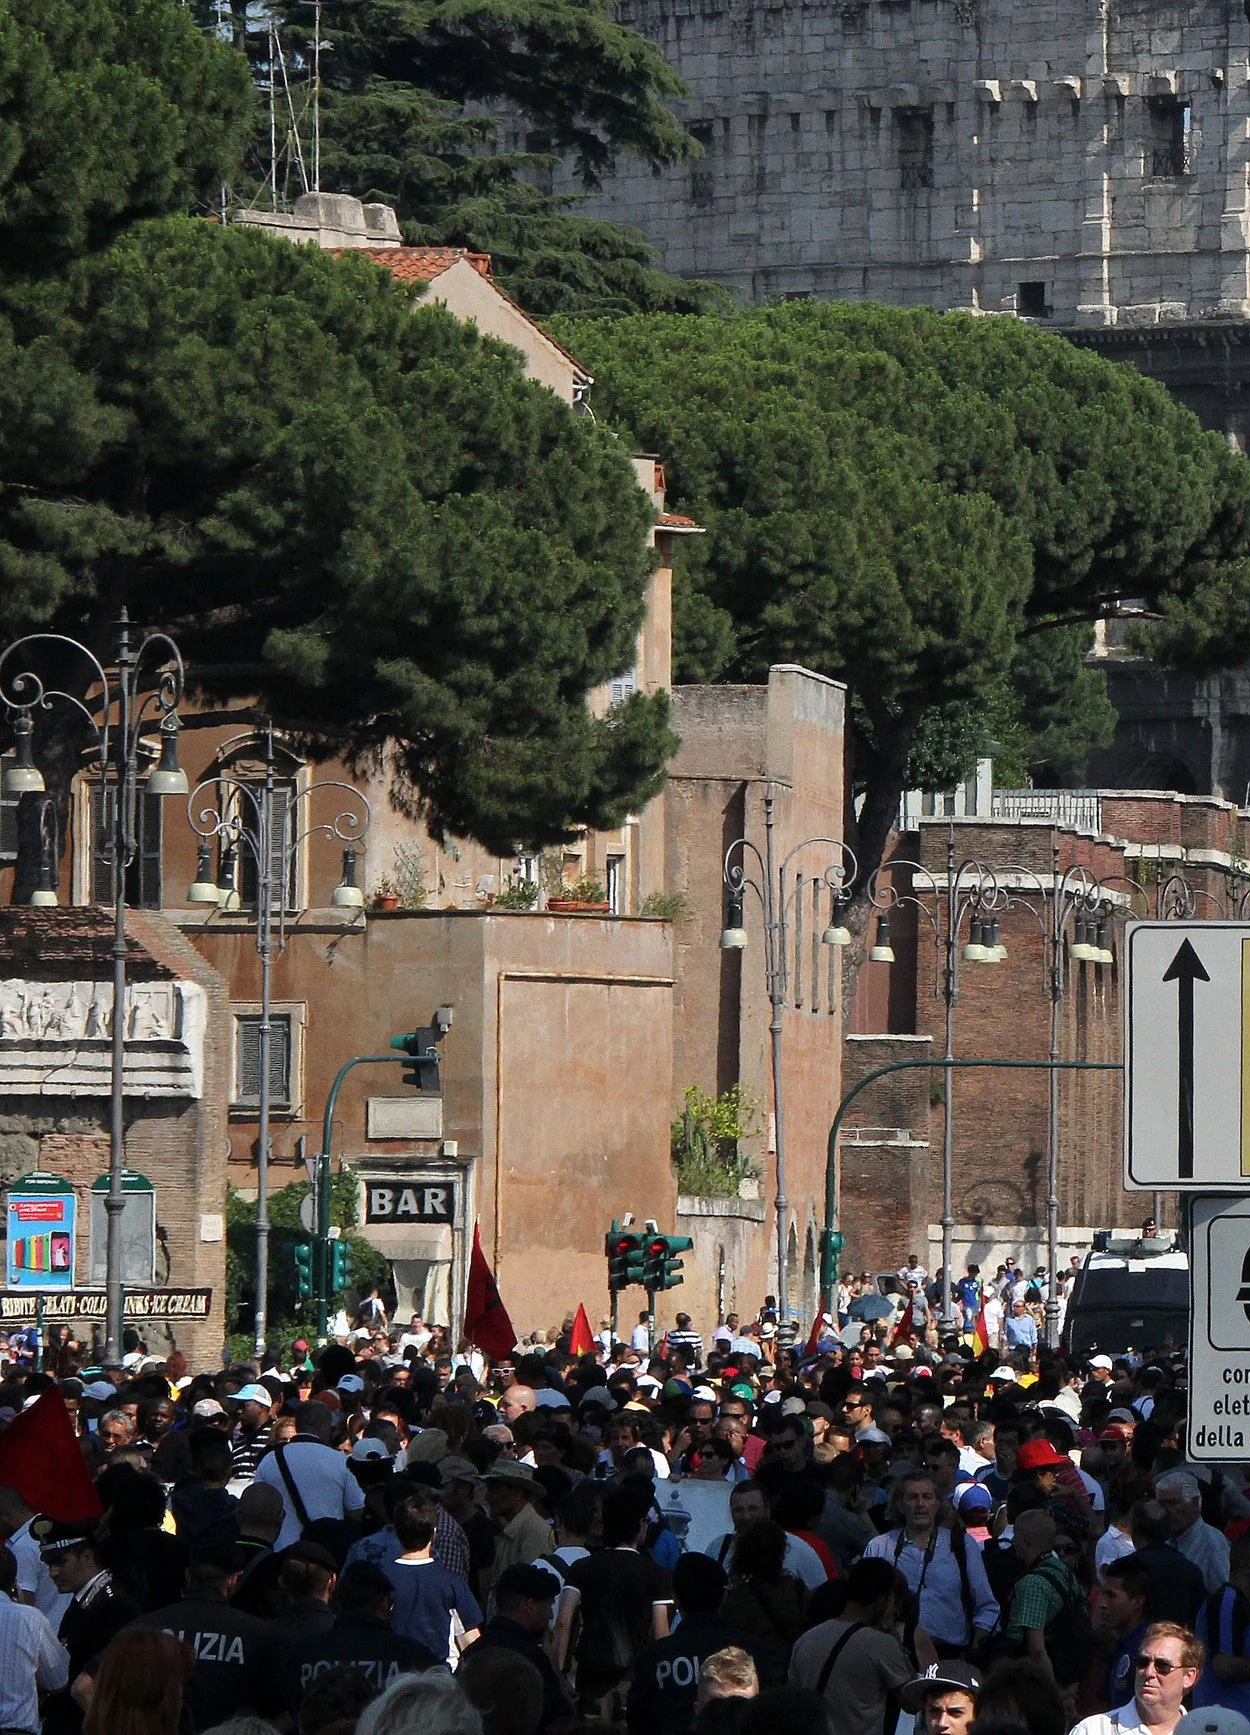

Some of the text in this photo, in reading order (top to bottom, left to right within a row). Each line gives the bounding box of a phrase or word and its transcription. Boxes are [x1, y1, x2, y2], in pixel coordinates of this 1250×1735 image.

[371, 1188, 447, 1215] BAR
[2, 1297, 36, 1317] BIBITE
[124, 1296, 149, 1314] INKS
[151, 1296, 168, 1314] ICE
[169, 1295, 207, 1314] CREAM
[1196, 1425, 1244, 1447] della
